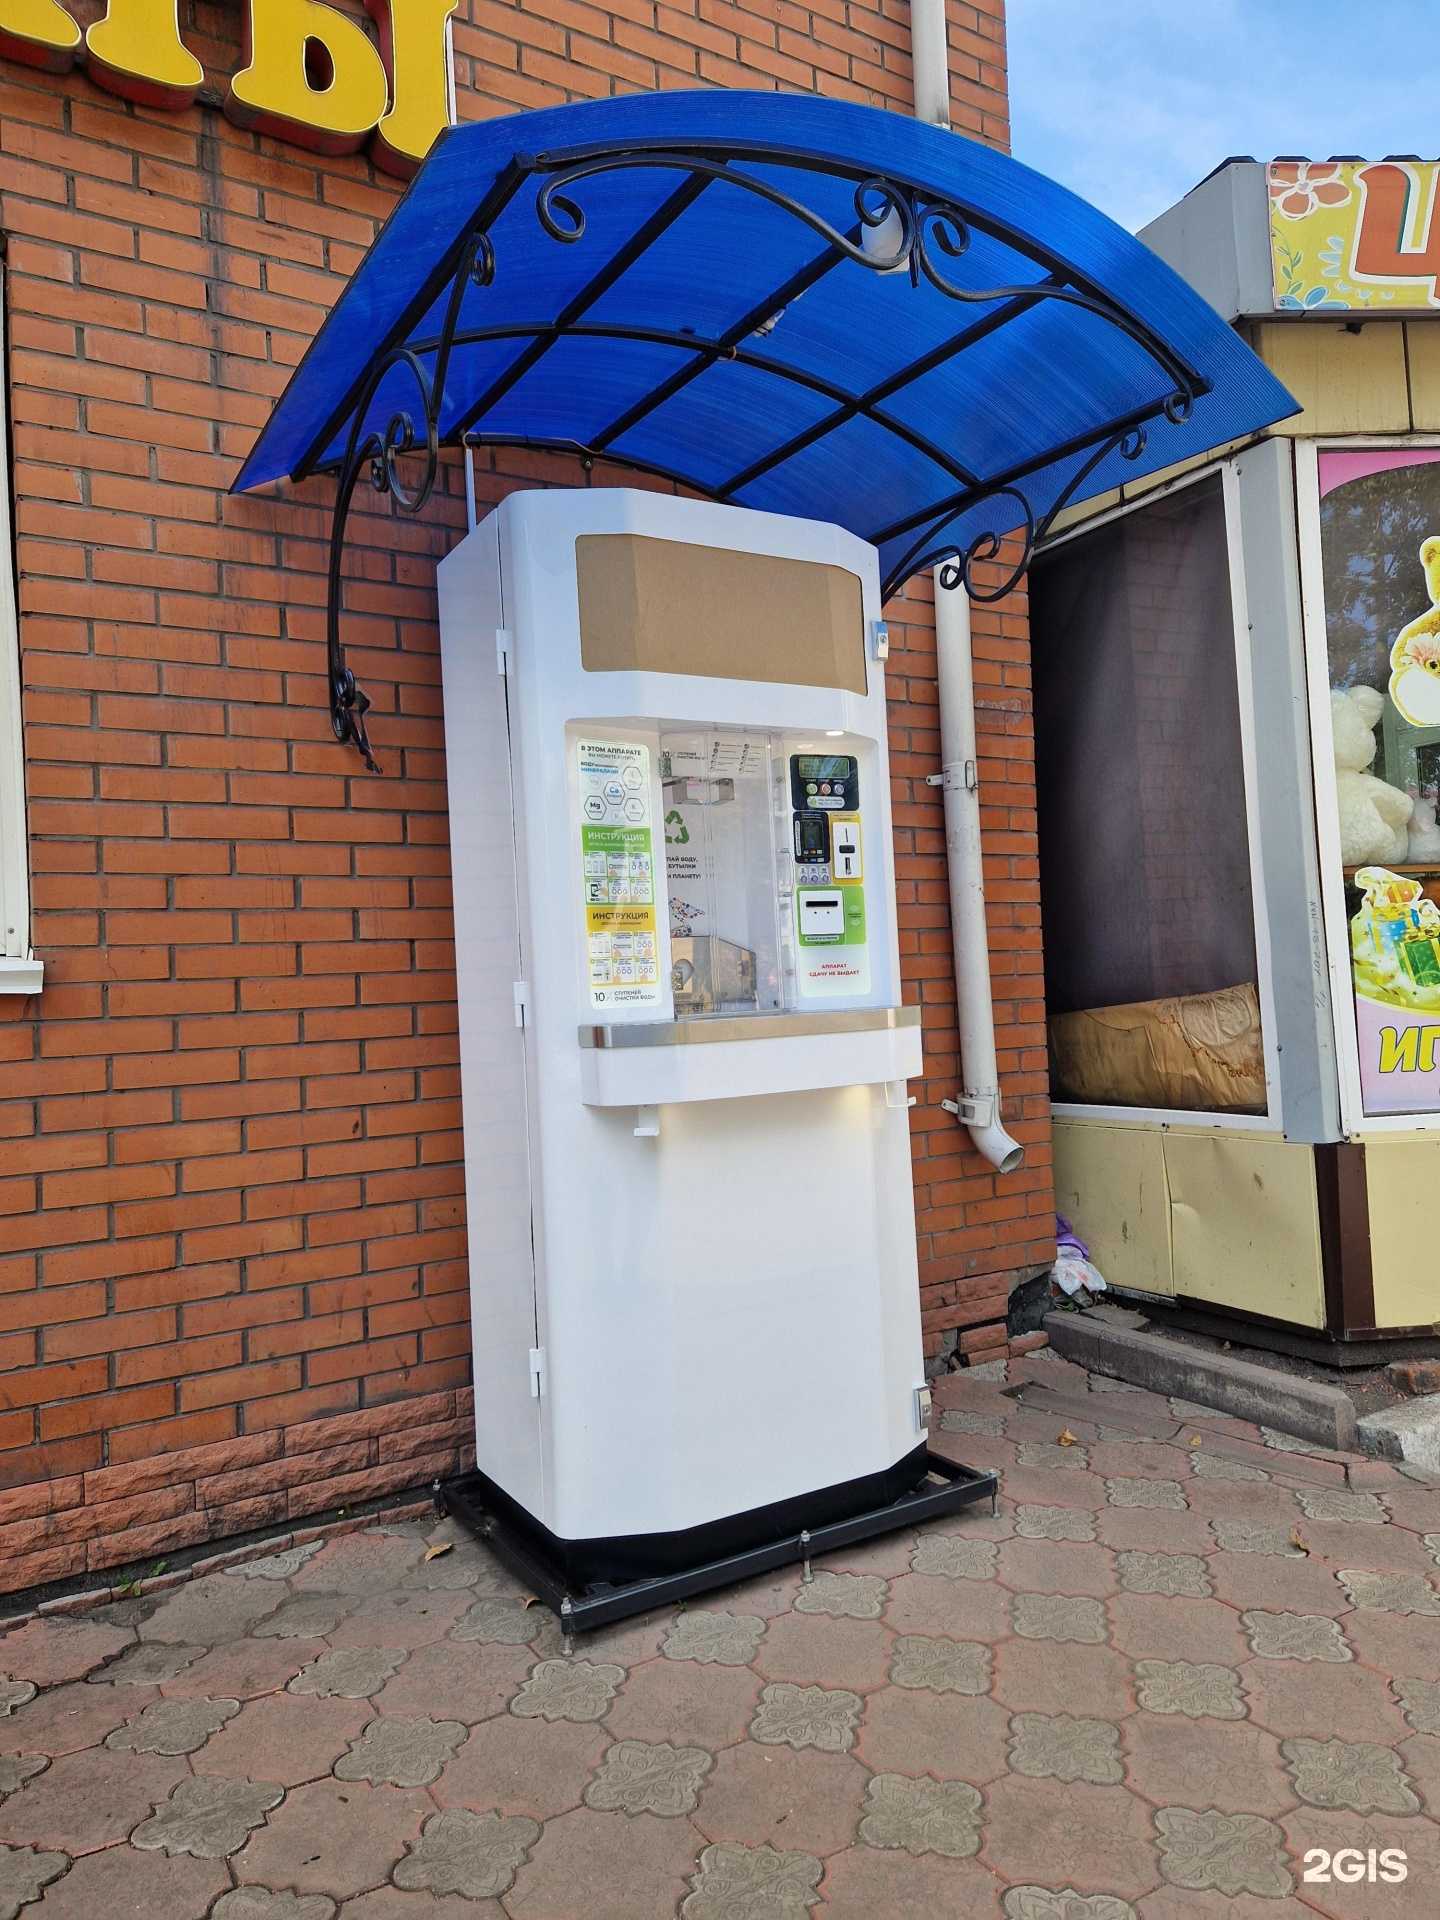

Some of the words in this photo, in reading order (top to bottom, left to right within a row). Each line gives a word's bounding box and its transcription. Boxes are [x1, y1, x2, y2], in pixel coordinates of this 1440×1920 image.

[607, 747, 641, 756] АППАРАТЕ
[590, 801, 601, 810] Mg
[588, 831, 645, 842] ИНСТРУКЦИЯ
[592, 911, 649, 920] ИНСТРУКЦИЯ
[594, 992, 605, 1002] 10
